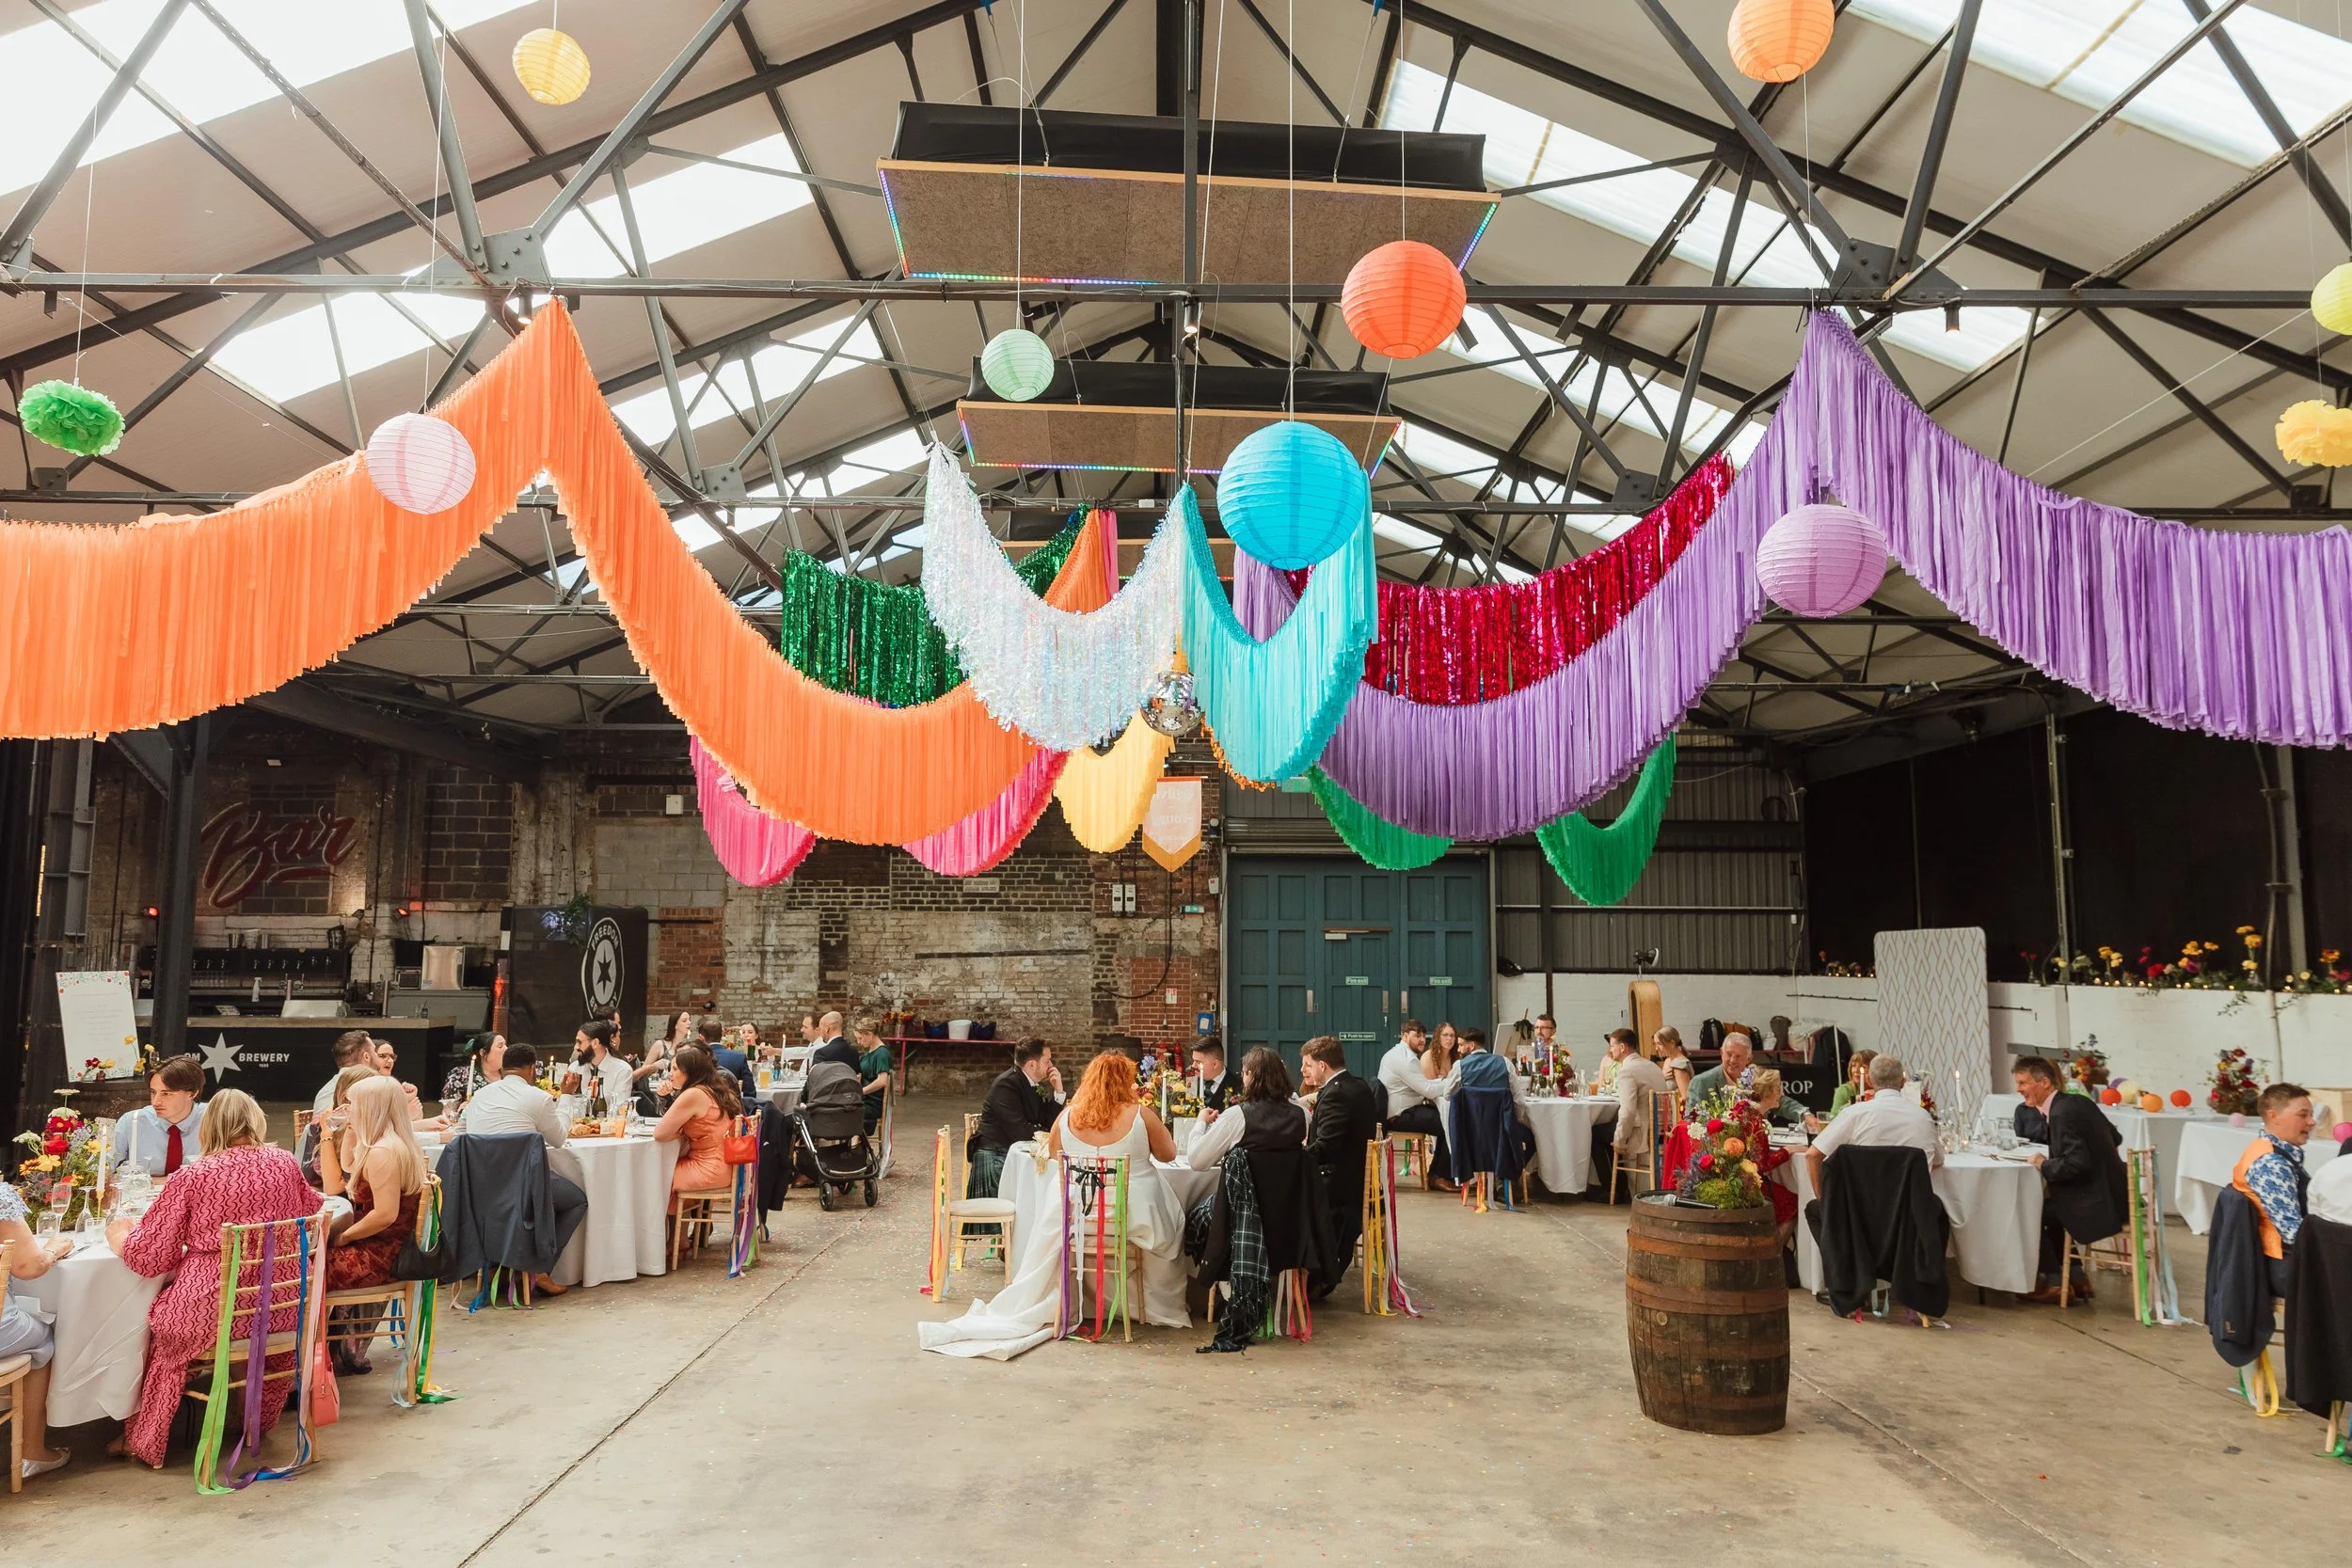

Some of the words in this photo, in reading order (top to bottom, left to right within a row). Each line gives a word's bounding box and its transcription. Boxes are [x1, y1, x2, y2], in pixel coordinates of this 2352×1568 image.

[200, 800, 357, 909] Bar
[591, 925, 619, 951] FREEDOM
[238, 1053, 290, 1062] BREWERY
[1781, 1080, 1814, 1094] ROP
